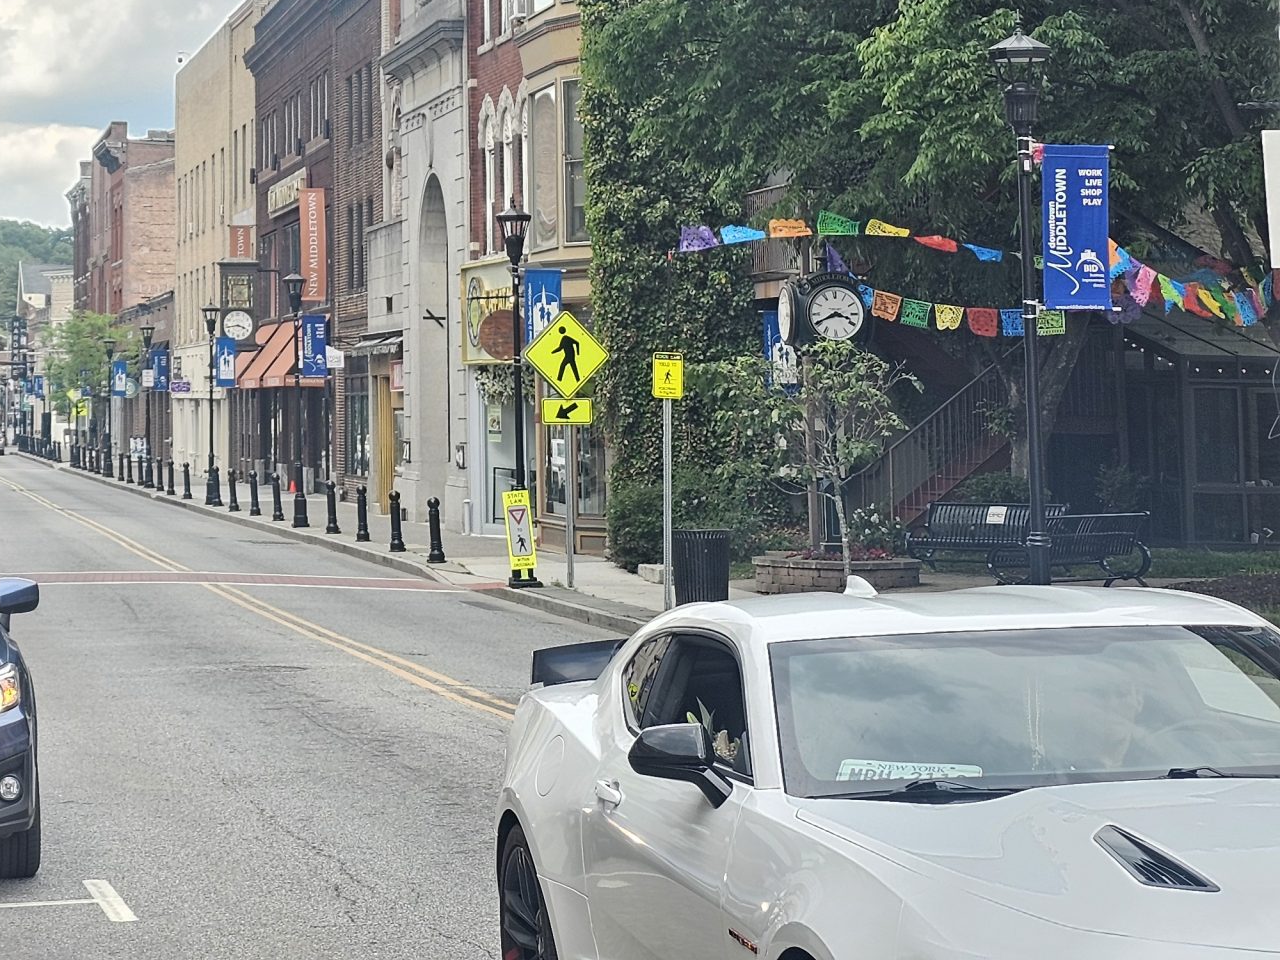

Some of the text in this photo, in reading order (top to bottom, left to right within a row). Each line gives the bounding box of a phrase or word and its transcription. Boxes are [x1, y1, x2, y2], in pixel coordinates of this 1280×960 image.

[308, 192, 317, 297] NEW MIDDLETOWN
[1047, 168, 1079, 295] MIDDLETOWN
[1084, 264, 1098, 273] BID
[877, 763, 946, 773] NEW YORK
